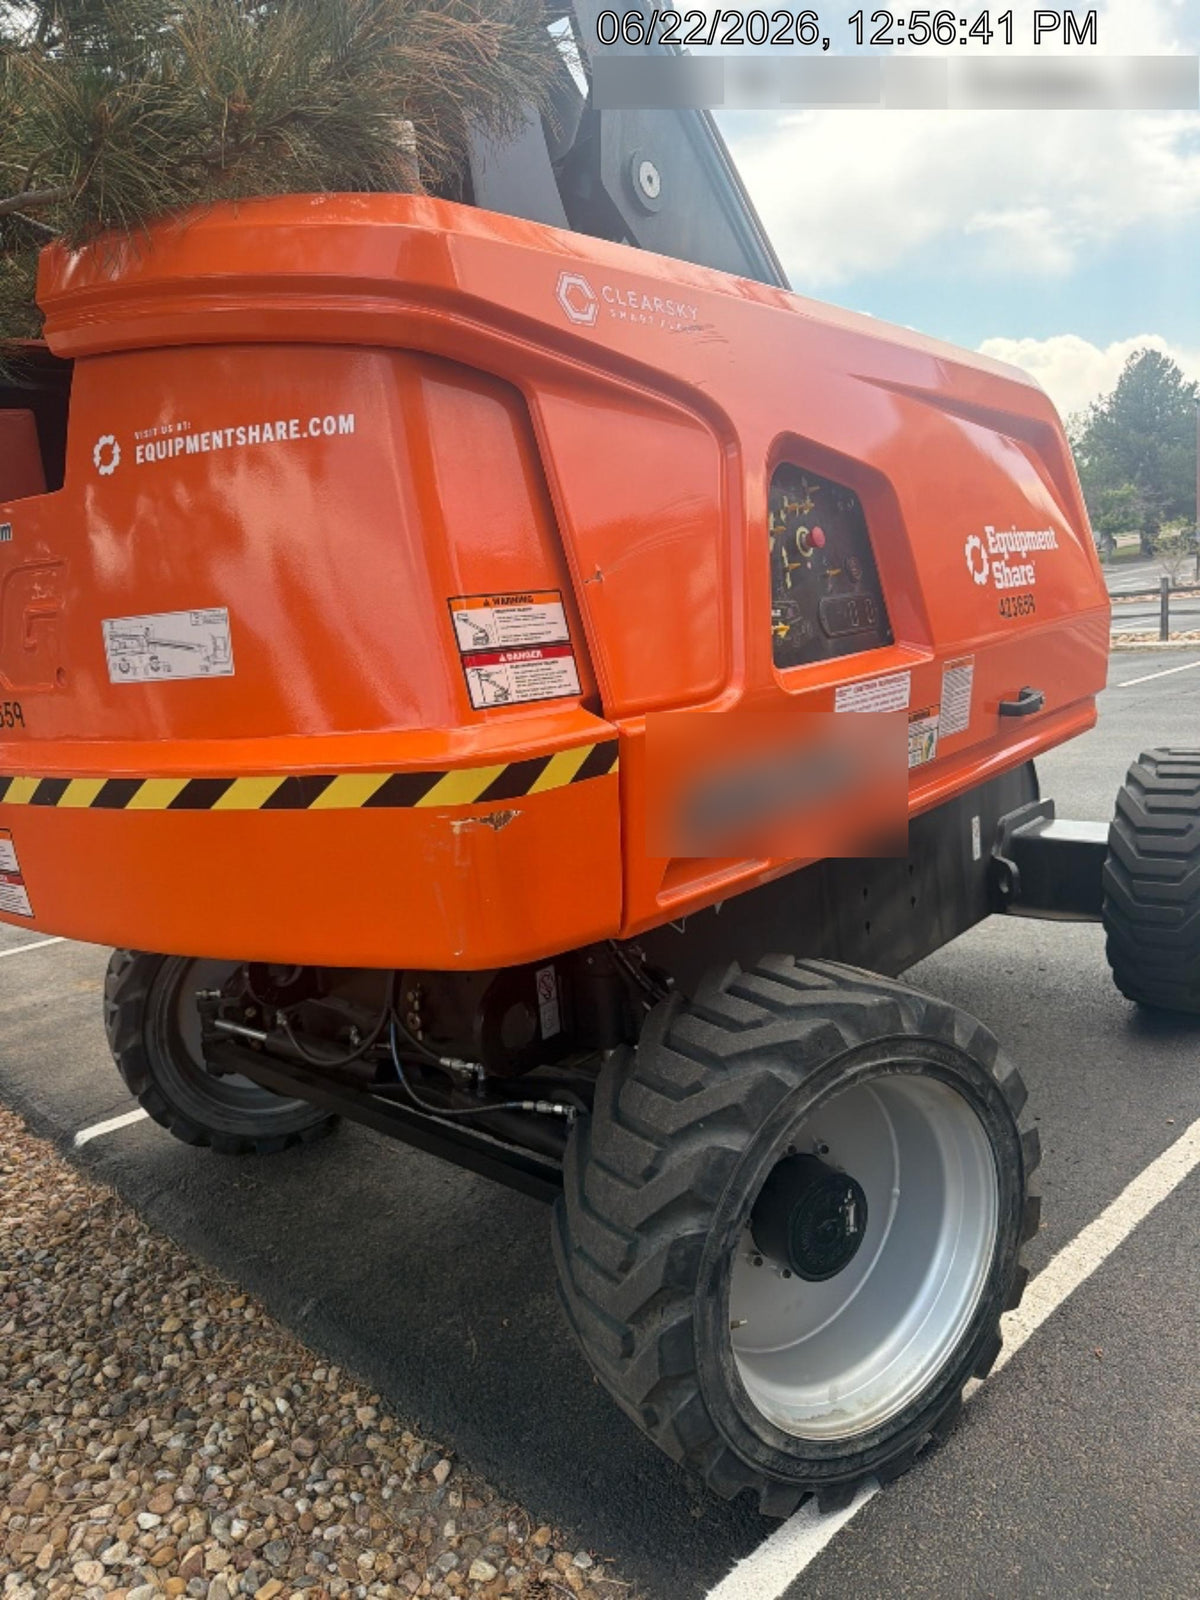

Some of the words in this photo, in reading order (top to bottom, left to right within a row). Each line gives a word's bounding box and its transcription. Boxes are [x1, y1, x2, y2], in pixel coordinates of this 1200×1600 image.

[601, 286, 699, 320] CLEARSKY
[134, 427, 157, 440] VISIT
[161, 424, 173, 435] US
[135, 413, 356, 465] EQUIPMENTSHARE.COM
[984, 525, 1059, 560] Equipment
[992, 560, 1036, 589] Share
